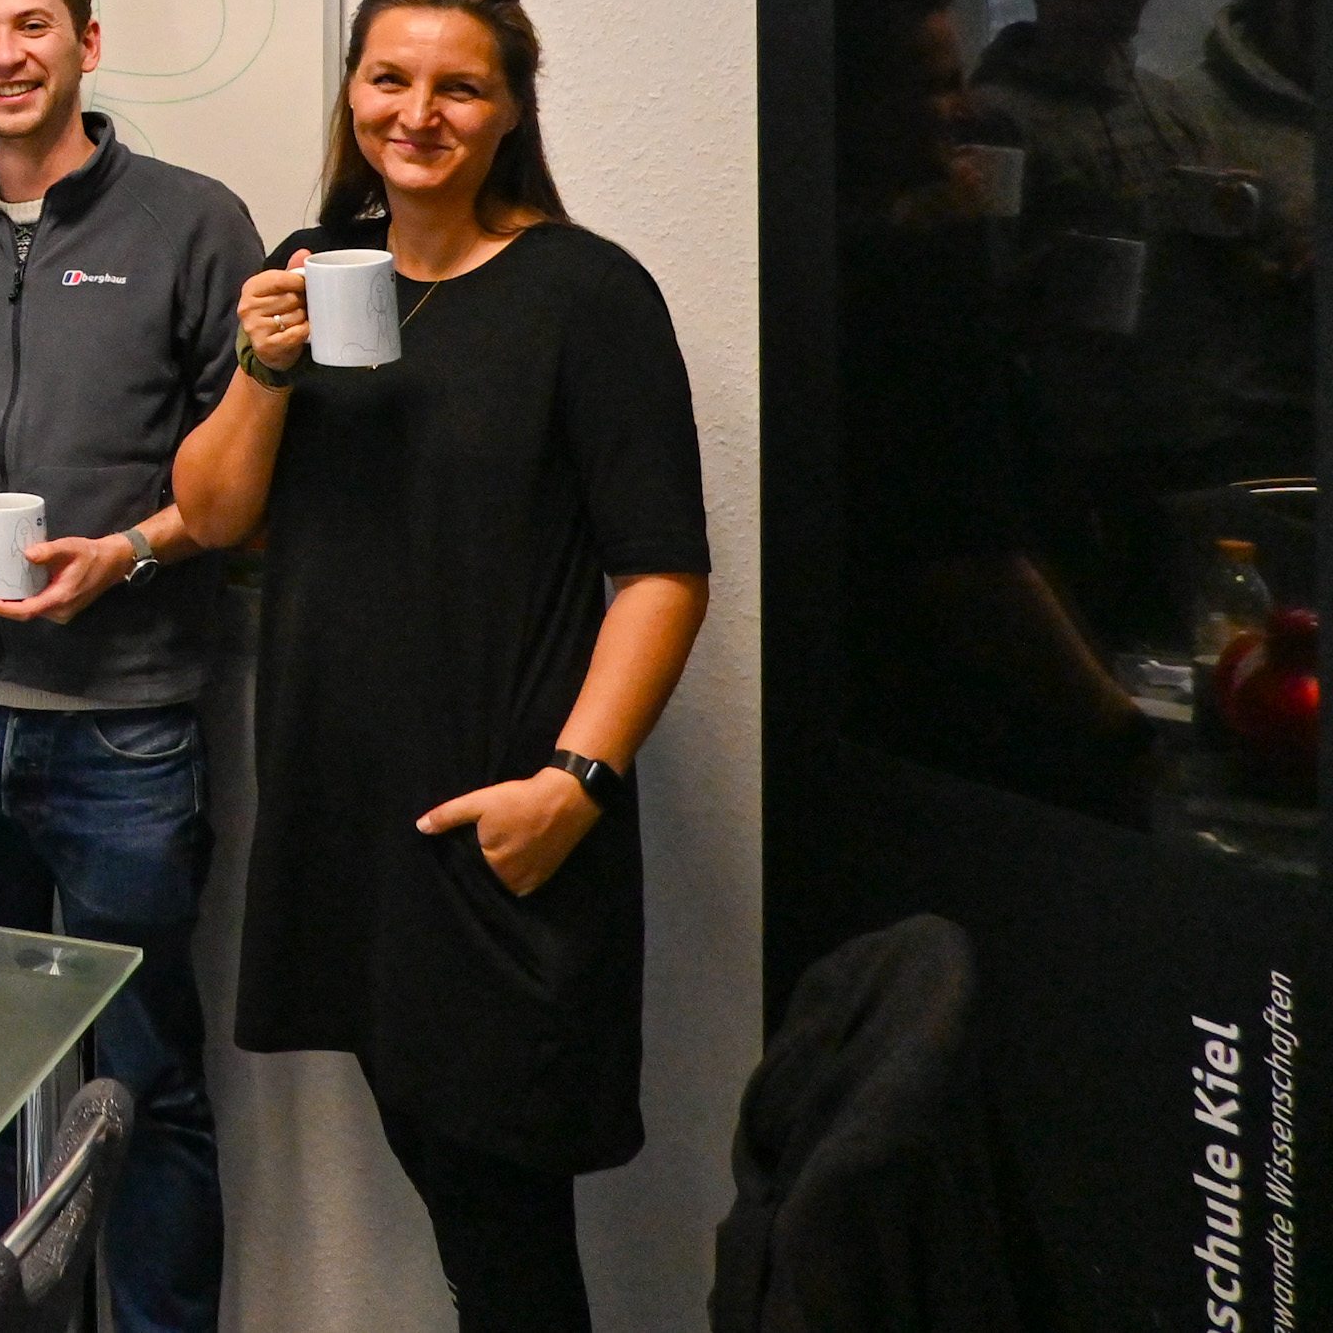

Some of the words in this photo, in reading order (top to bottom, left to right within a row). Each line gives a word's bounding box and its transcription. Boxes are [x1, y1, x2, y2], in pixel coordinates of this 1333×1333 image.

[81, 272, 127, 284] berghaus
[1191, 1014, 1240, 1136] Kiel
[1262, 969, 1301, 1208] Wissenschaften
[1192, 1143, 1241, 1333] schule
